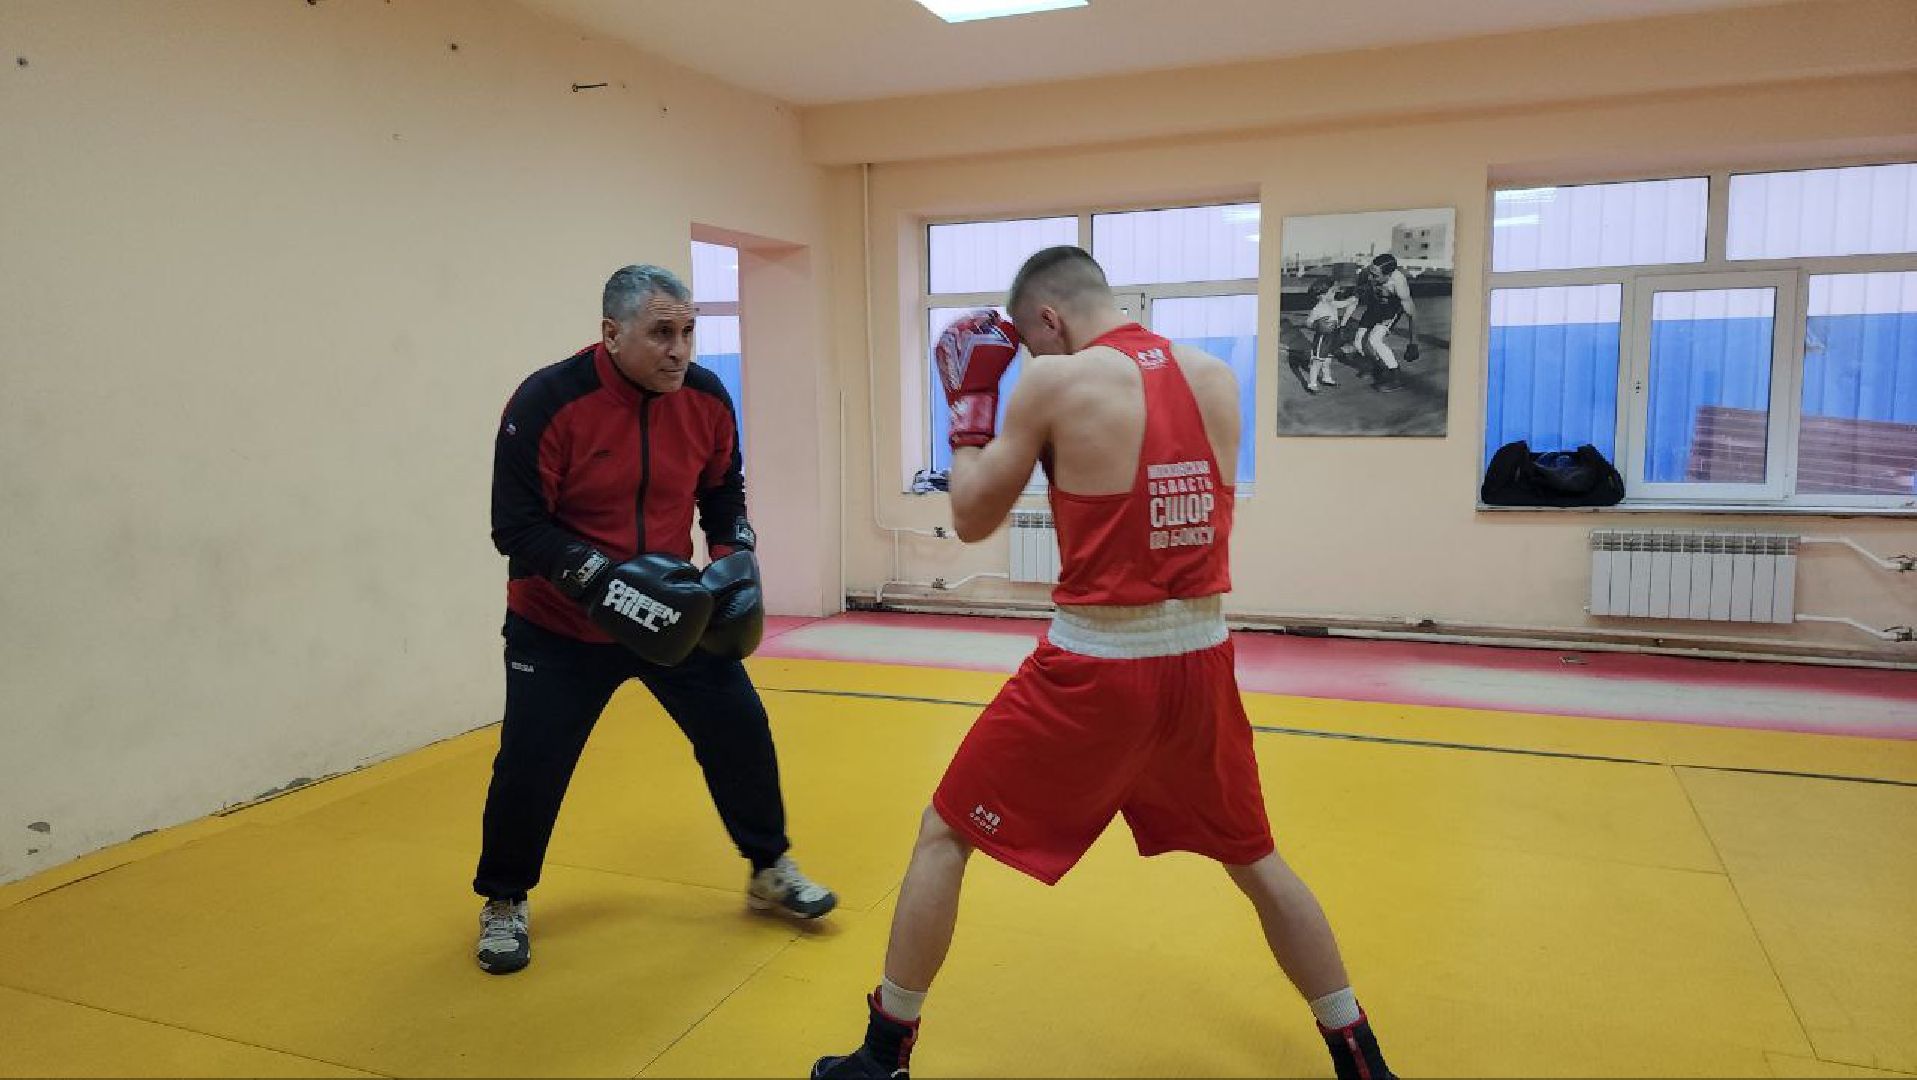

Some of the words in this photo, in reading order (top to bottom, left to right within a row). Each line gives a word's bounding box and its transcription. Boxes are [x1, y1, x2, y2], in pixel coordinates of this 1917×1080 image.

[1149, 476, 1214, 495] ОБЛАСТЬ
[1150, 493, 1214, 528] СШОР
[1149, 530, 1169, 550] ПО
[602, 590, 660, 633] HILL
[608, 578, 682, 627] GREEN
